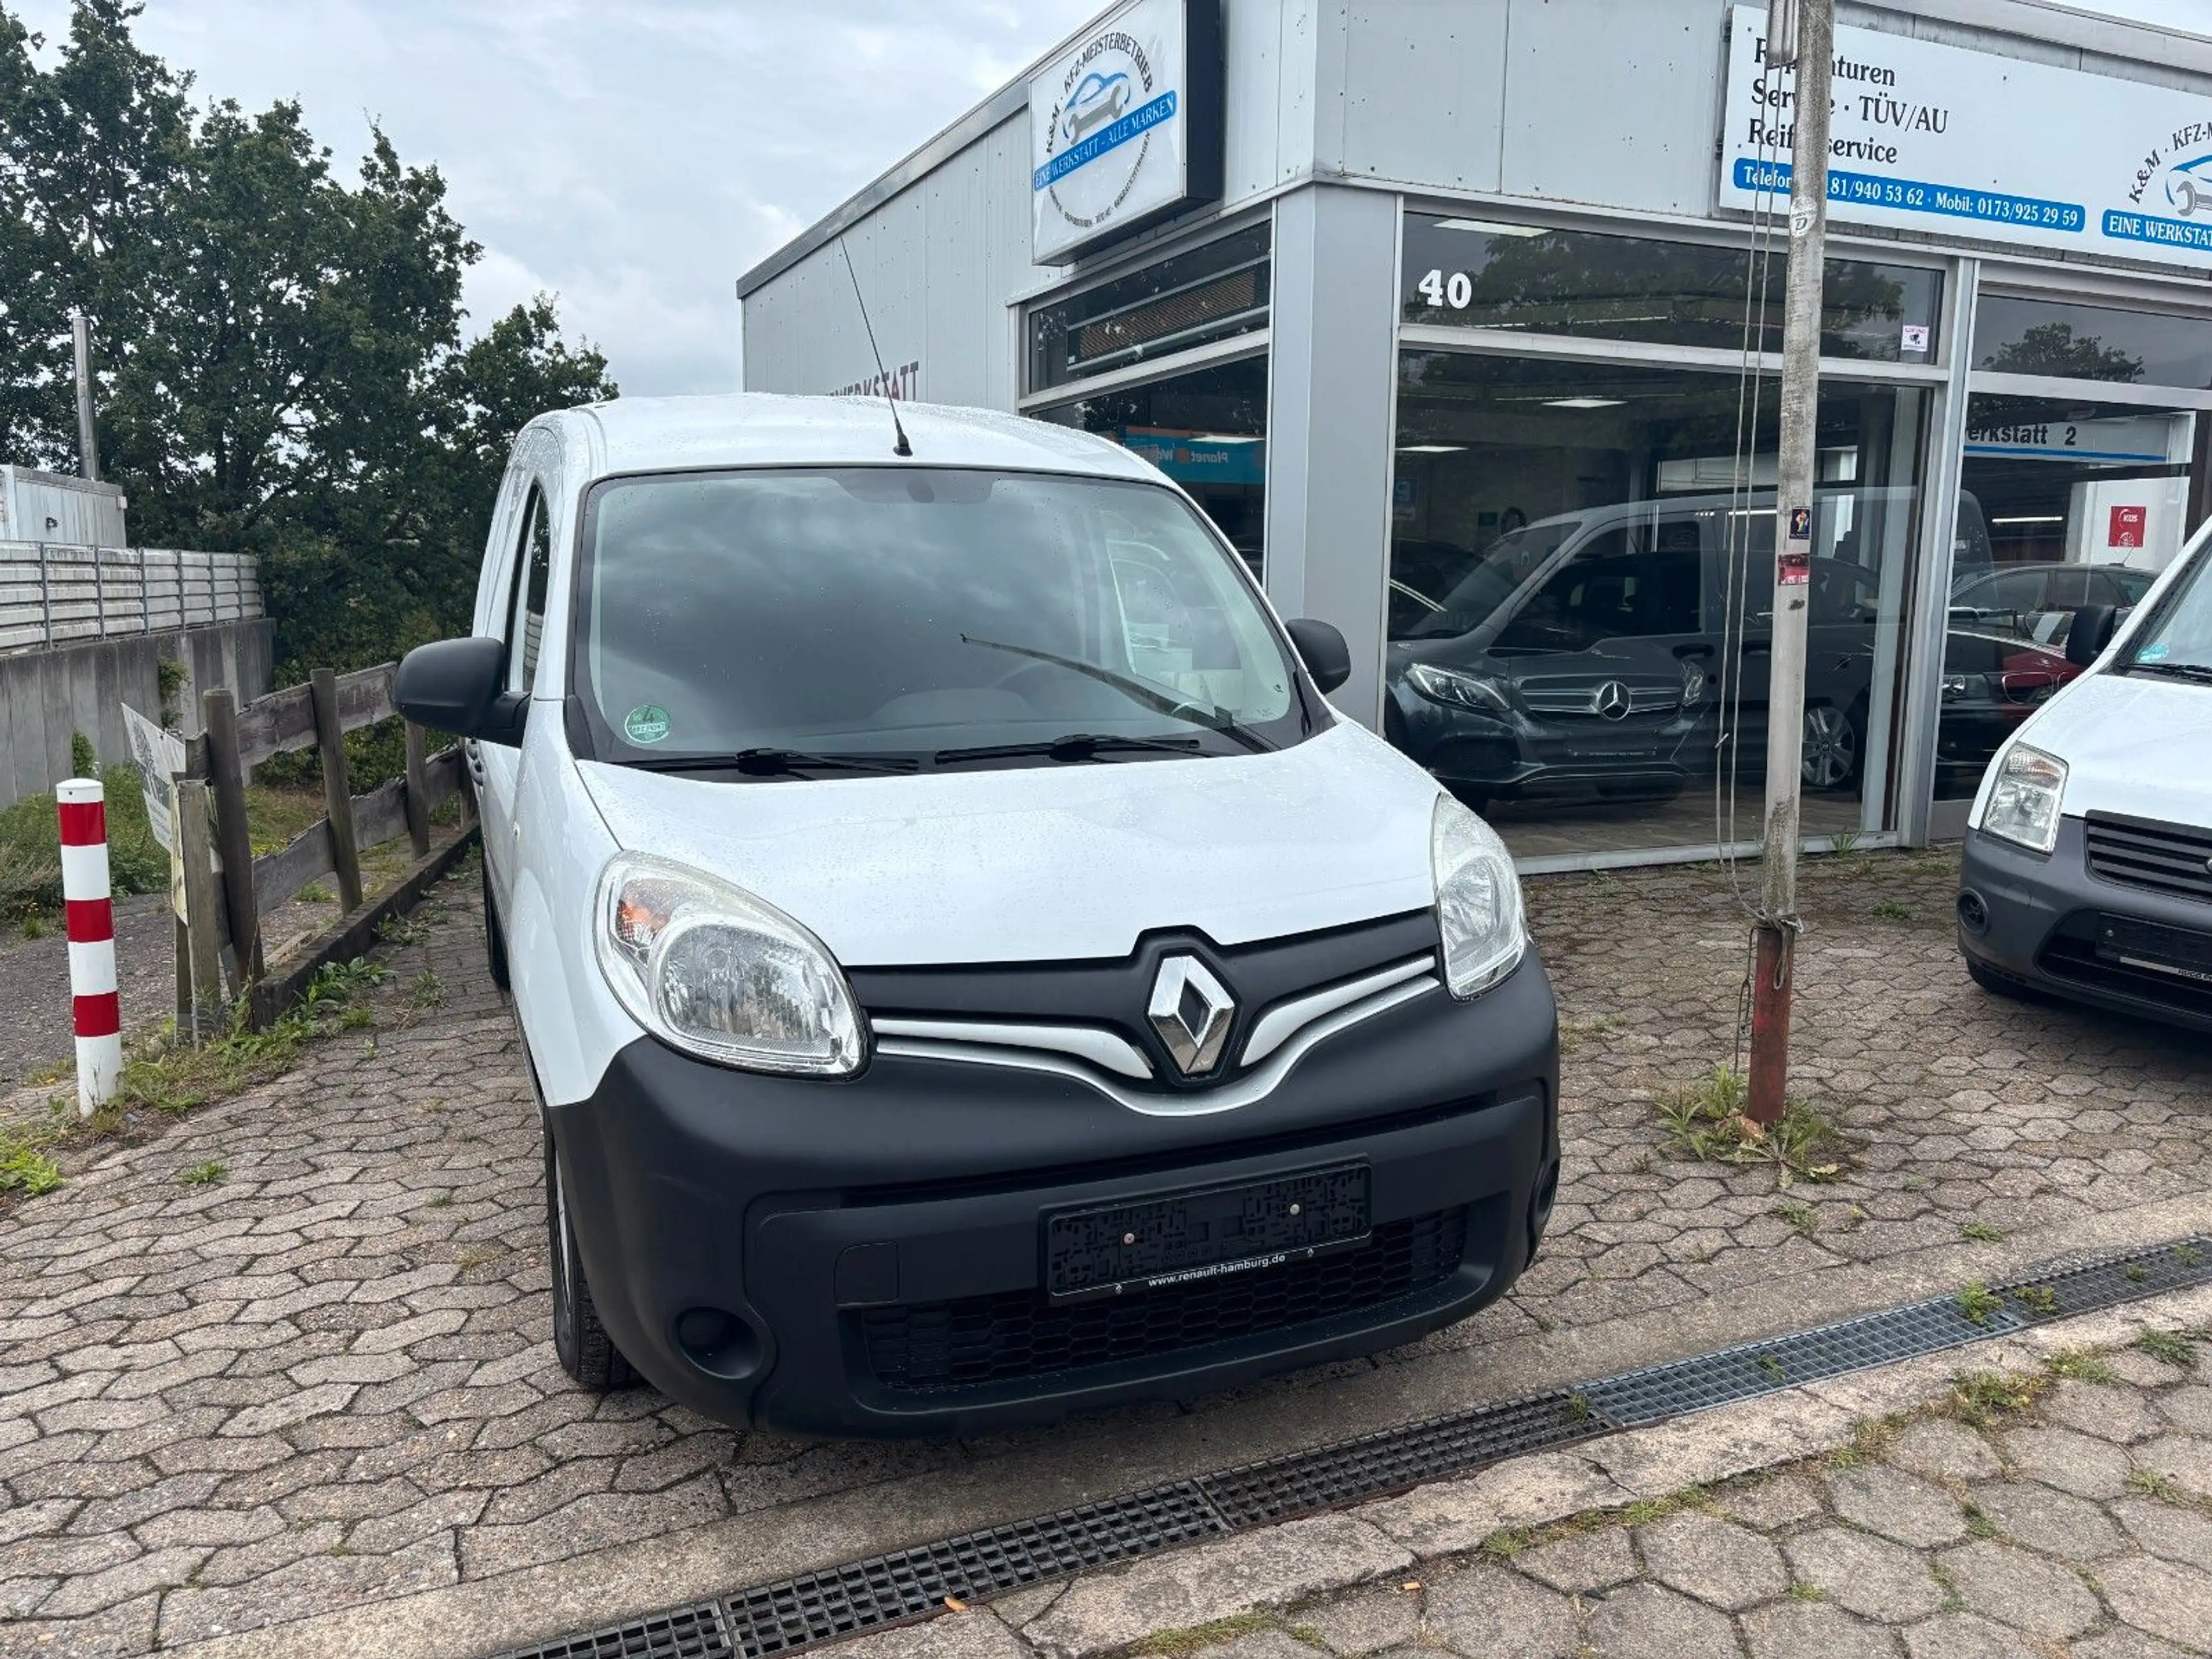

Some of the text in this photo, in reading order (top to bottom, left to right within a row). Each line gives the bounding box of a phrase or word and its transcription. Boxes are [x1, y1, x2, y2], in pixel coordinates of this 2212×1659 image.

[1064, 32, 1153, 94] KFZ-MEISTERBETRIEB
[1859, 91, 1949, 134] TÜV/AU
[1035, 94, 1175, 188] EINE WERKSTATT ALLE MARKEN
[2128, 148, 2161, 204] K&M
[1885, 184, 1902, 203] 53
[1907, 188, 1925, 206] 62
[1936, 191, 1974, 213] Mobil:
[1977, 196, 2039, 223] 0173/925
[2043, 207, 2059, 225] 29
[2062, 209, 2078, 227] 59
[2109, 214, 2142, 236] EINE
[1418, 268, 1472, 309] 40
[2065, 426, 2077, 446] 2
[1148, 1254, 1286, 1287] www.renault-hamburg.de
